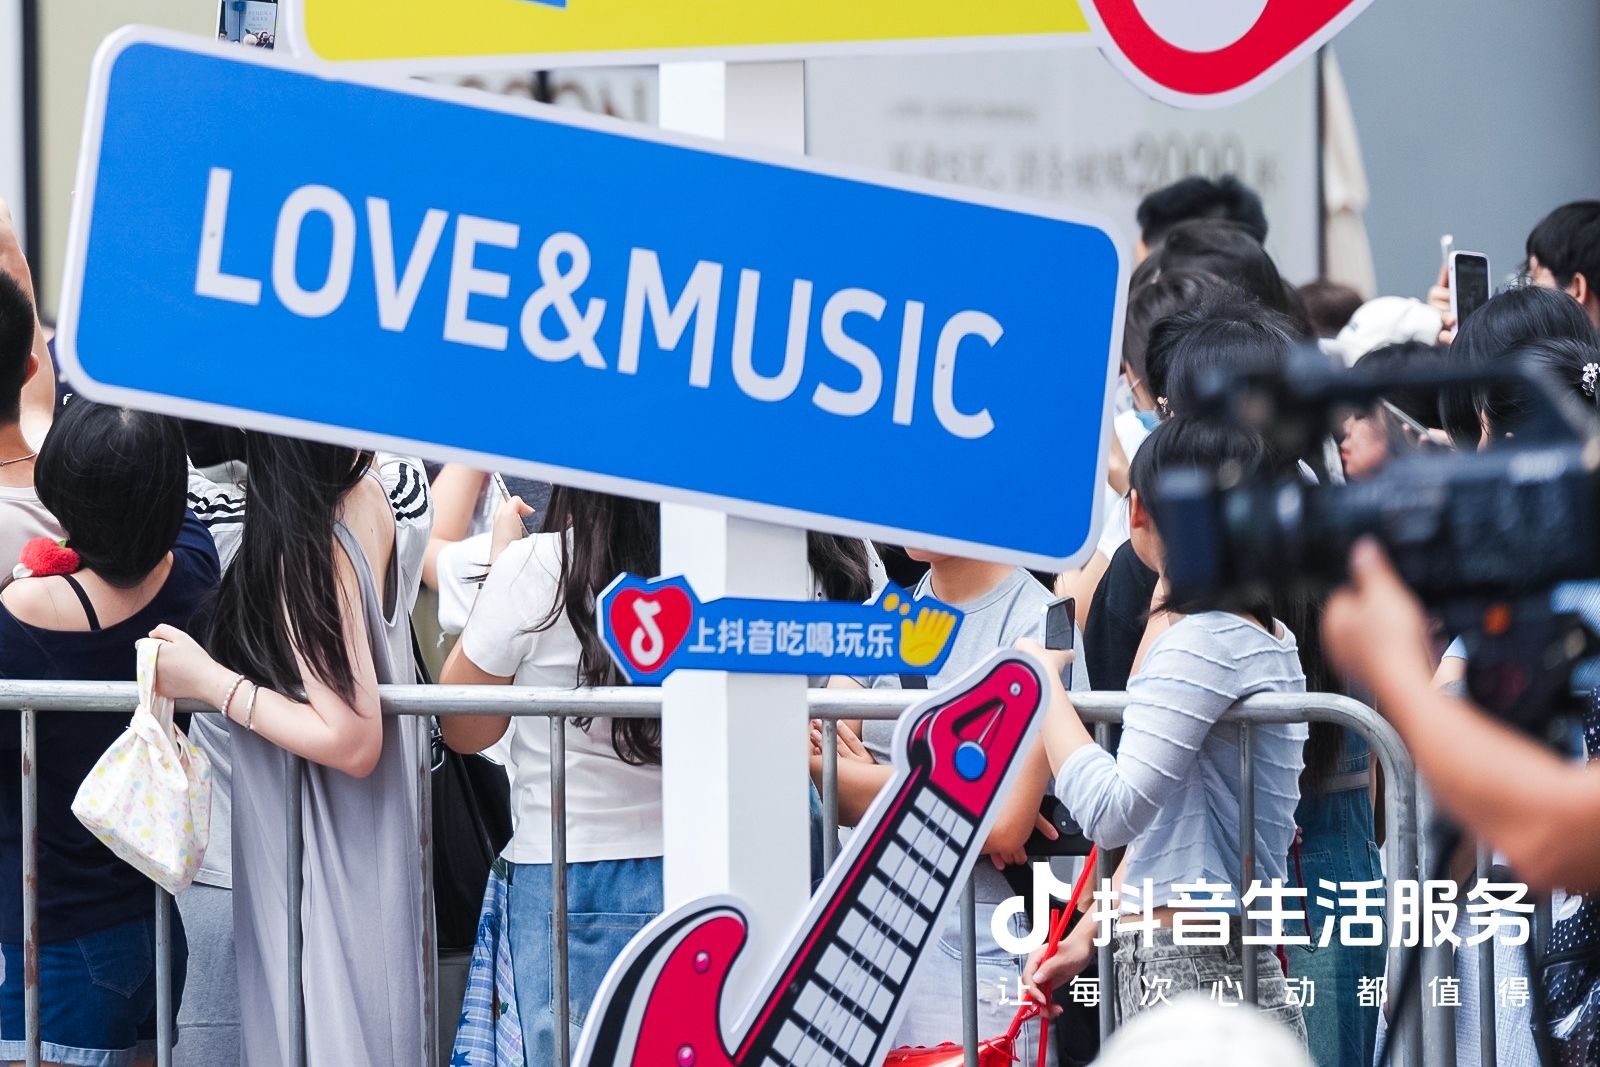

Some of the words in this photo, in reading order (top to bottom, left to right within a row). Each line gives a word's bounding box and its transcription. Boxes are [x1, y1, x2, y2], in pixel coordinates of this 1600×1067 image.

[195, 167, 1004, 440] LOVE&MUSIC
[688, 618, 893, 659] 上抖音吃喝玩乐
